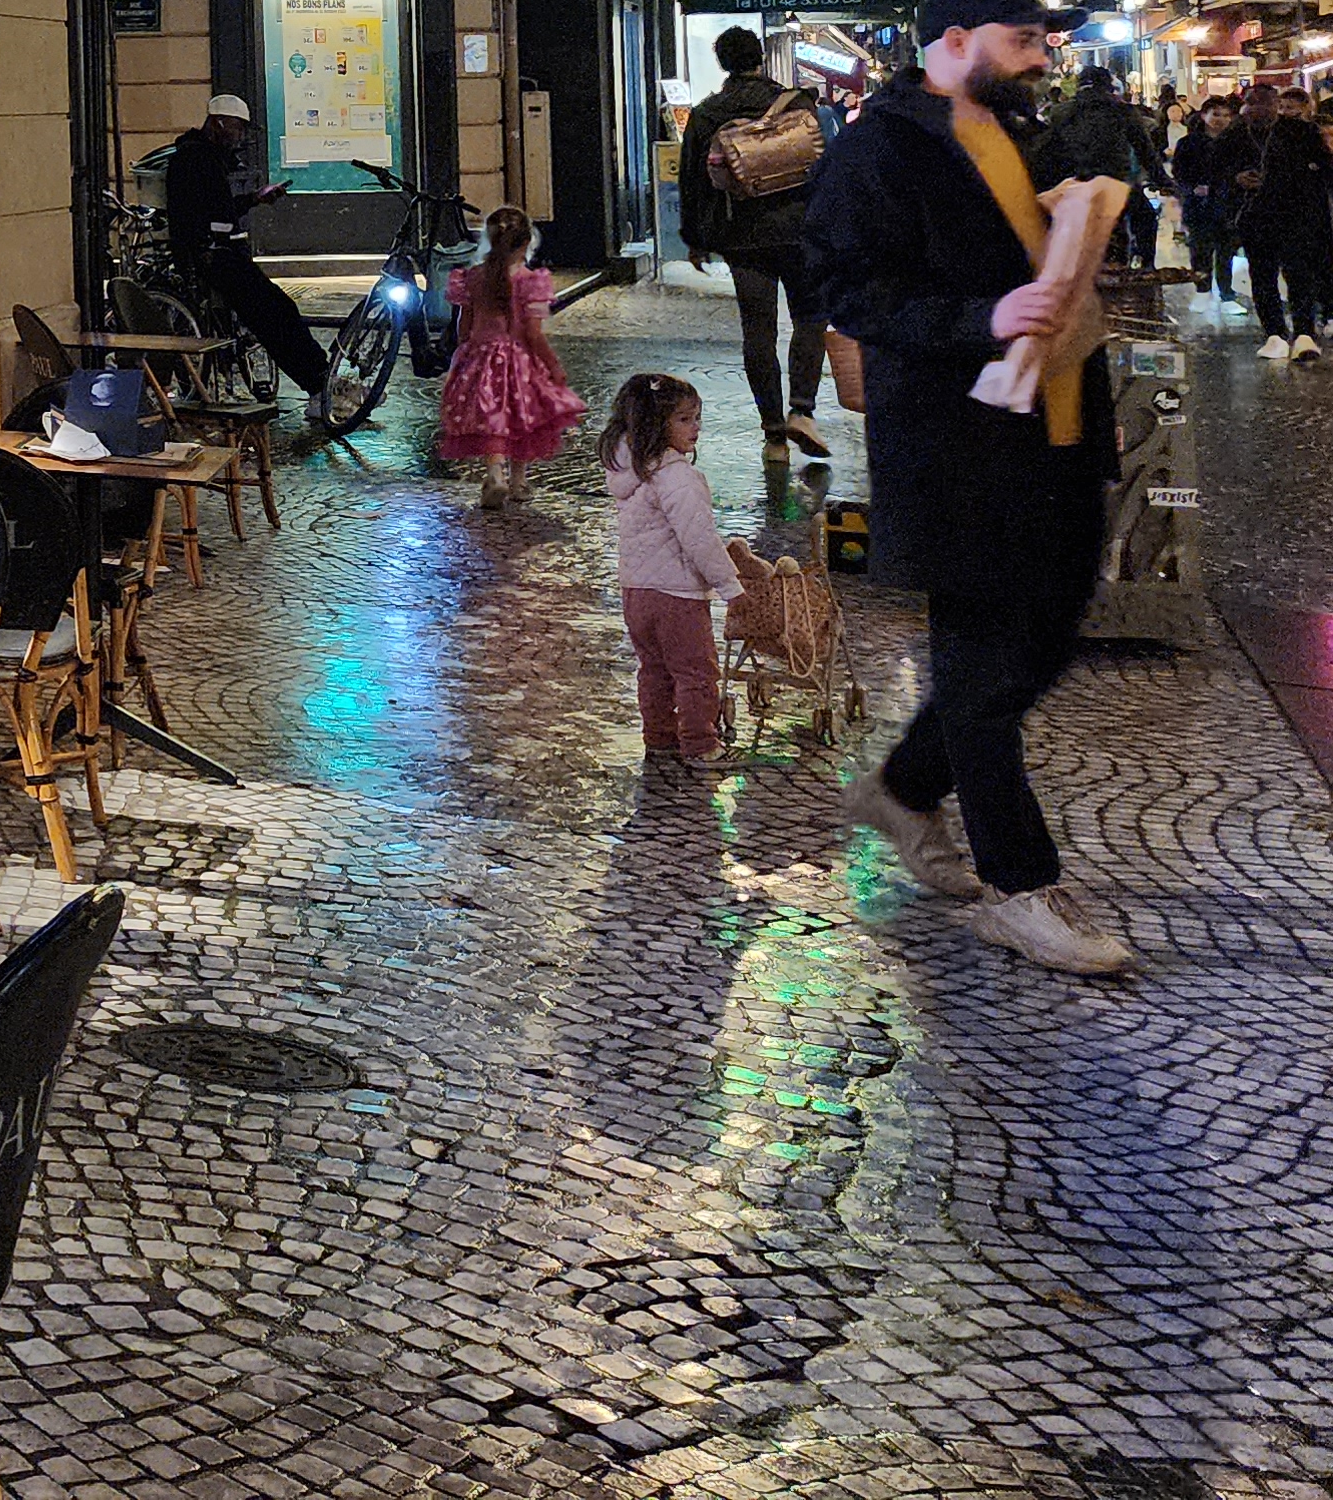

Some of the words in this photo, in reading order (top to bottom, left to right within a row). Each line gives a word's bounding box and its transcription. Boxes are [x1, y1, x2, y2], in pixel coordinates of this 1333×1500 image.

[286, 0, 301, 9] NOS
[302, 0, 322, 9] BONS
[323, 0, 346, 9] PLANS
